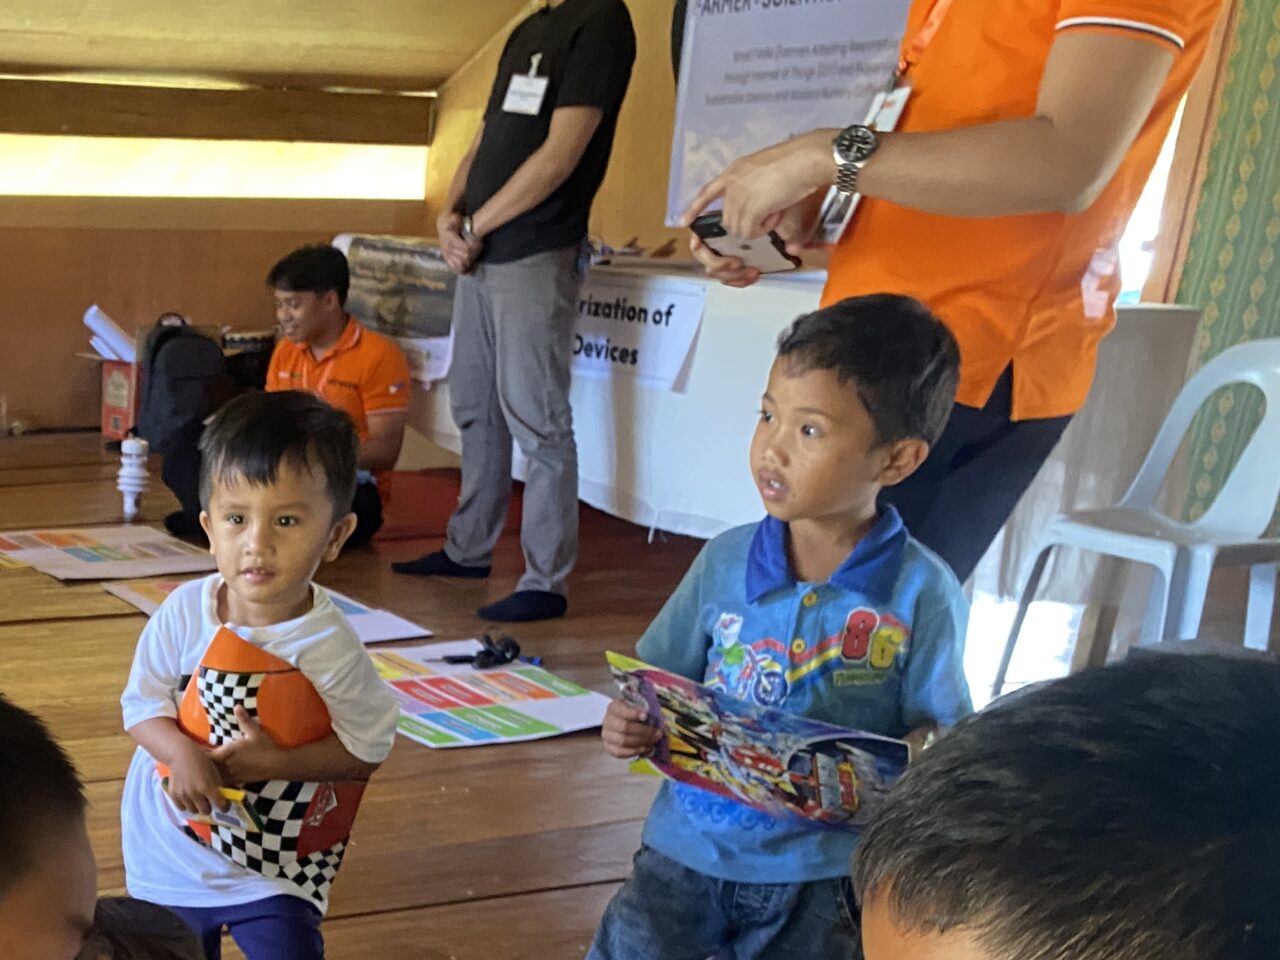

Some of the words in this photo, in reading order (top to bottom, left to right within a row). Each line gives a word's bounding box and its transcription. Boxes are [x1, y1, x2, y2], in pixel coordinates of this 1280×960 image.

[580, 294, 648, 324] rization
[652, 303, 675, 327] of
[573, 333, 639, 365] Devices
[841, 607, 904, 669] 86
